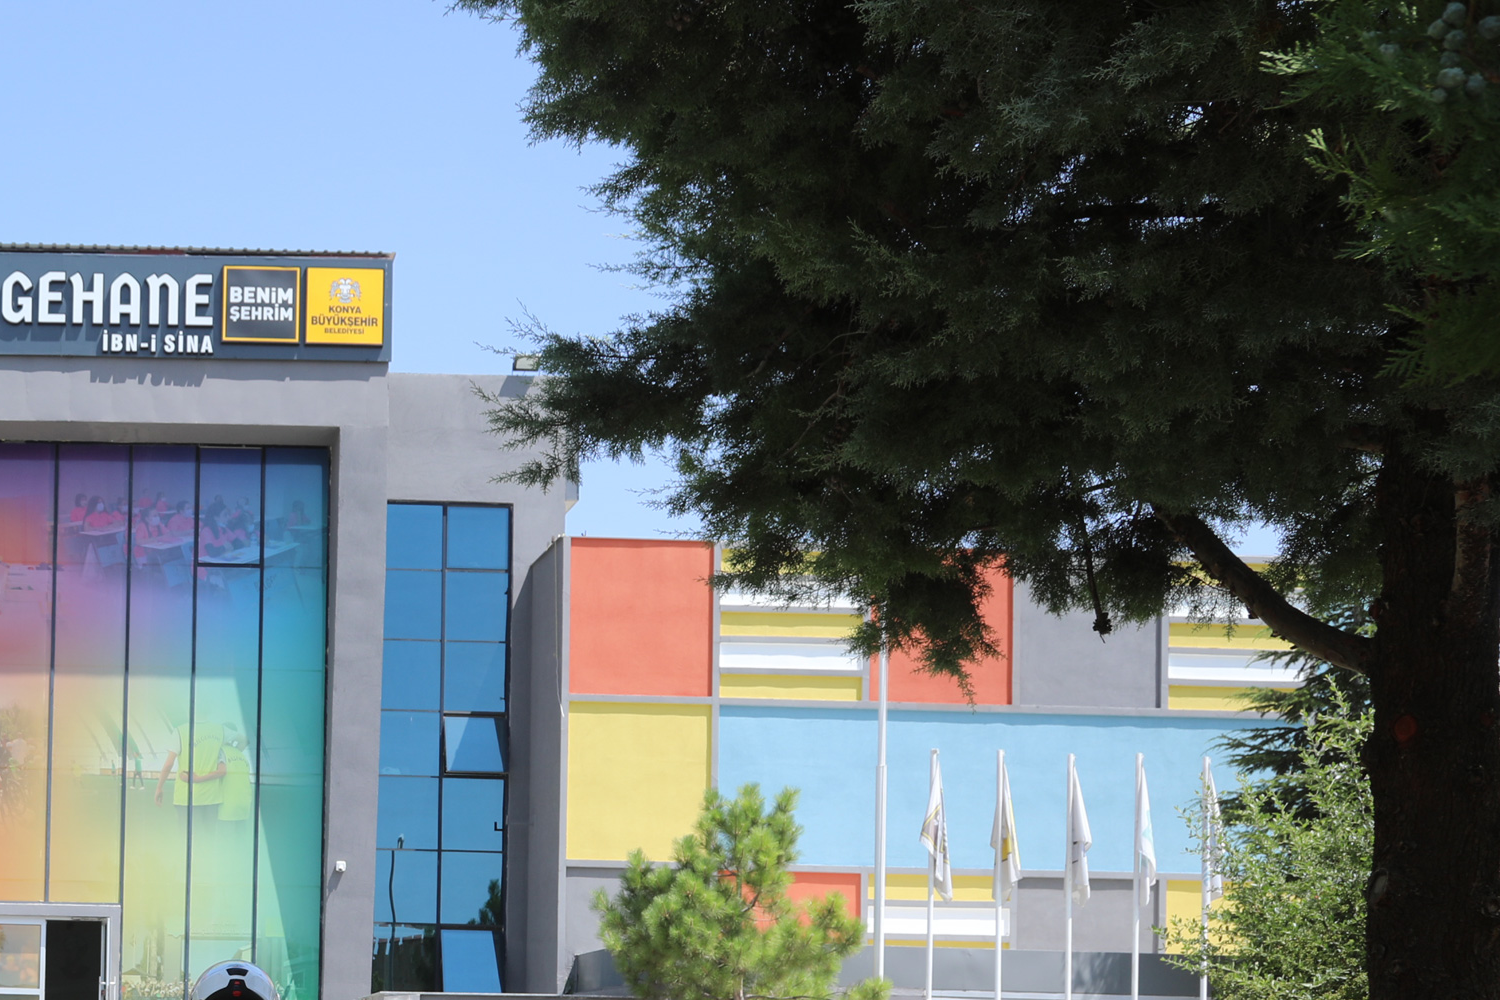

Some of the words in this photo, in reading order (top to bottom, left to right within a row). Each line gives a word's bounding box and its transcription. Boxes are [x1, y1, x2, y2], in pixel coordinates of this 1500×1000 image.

[328, 305, 362, 314] KONYA
[311, 314, 378, 327] BÜYÜKŞEHİR
[164, 331, 214, 354] SİNA
